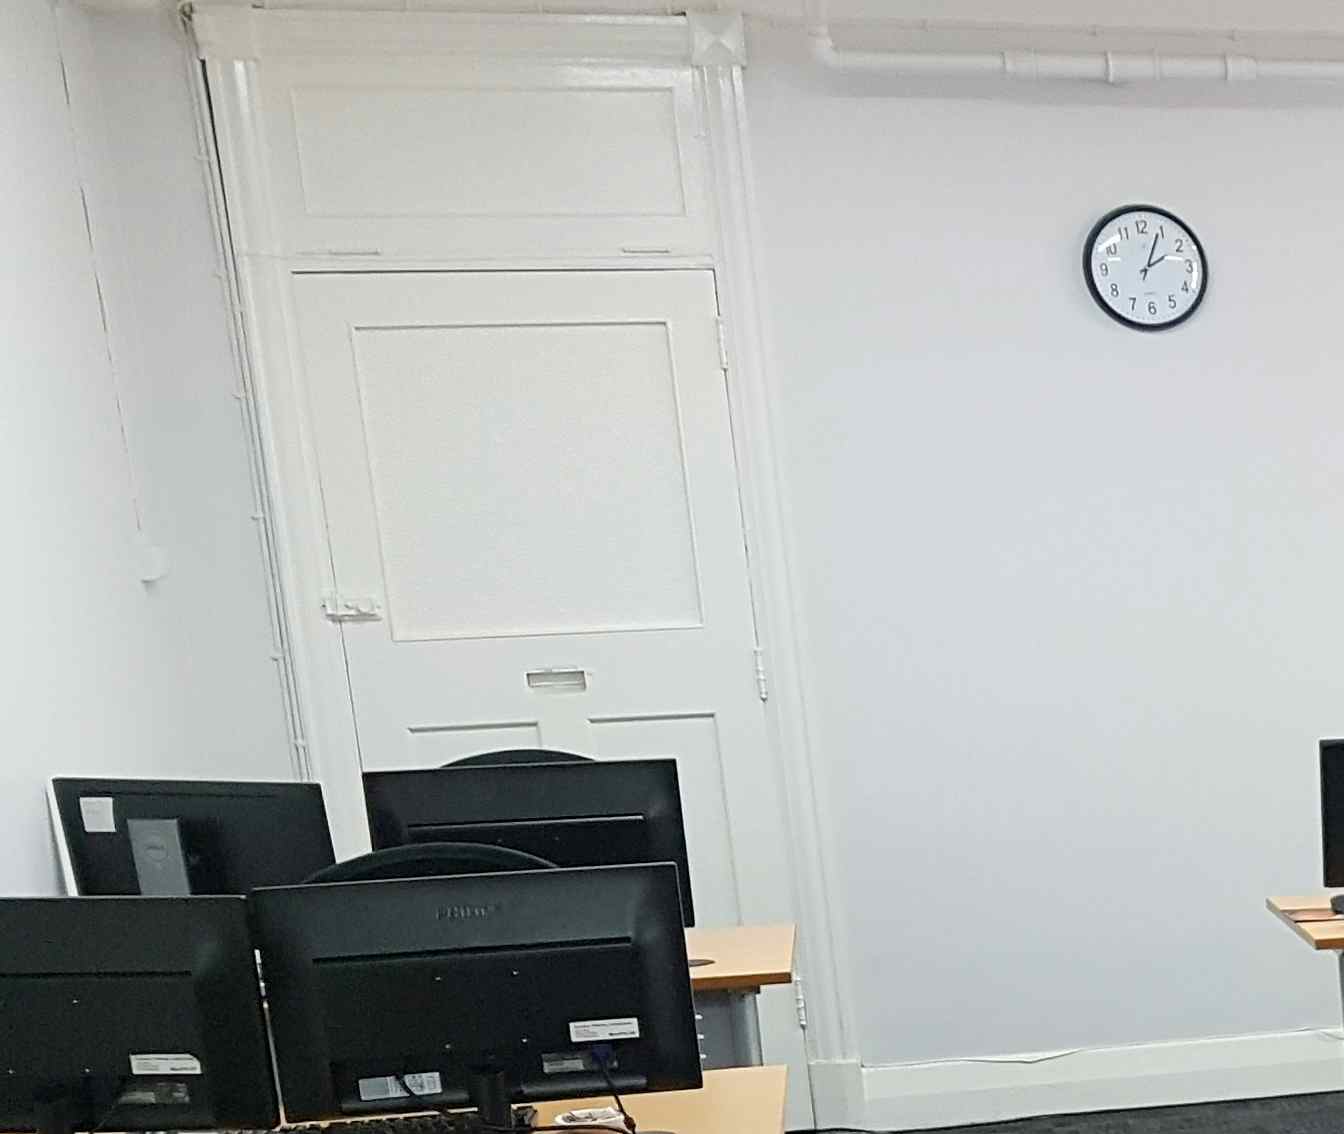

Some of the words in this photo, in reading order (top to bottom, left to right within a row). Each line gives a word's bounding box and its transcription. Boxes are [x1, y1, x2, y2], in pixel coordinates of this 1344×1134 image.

[1118, 226, 1129, 241] 11
[1135, 220, 1148, 234] 12
[1175, 238, 1184, 253] 2
[1100, 262, 1109, 277] 9
[1185, 259, 1194, 274] 3
[1110, 283, 1119, 298] 8
[1181, 280, 1189, 294] 4
[1128, 297, 1137, 312] 7
[1148, 301, 1157, 316] 6
[1168, 294, 1177, 309] 5
